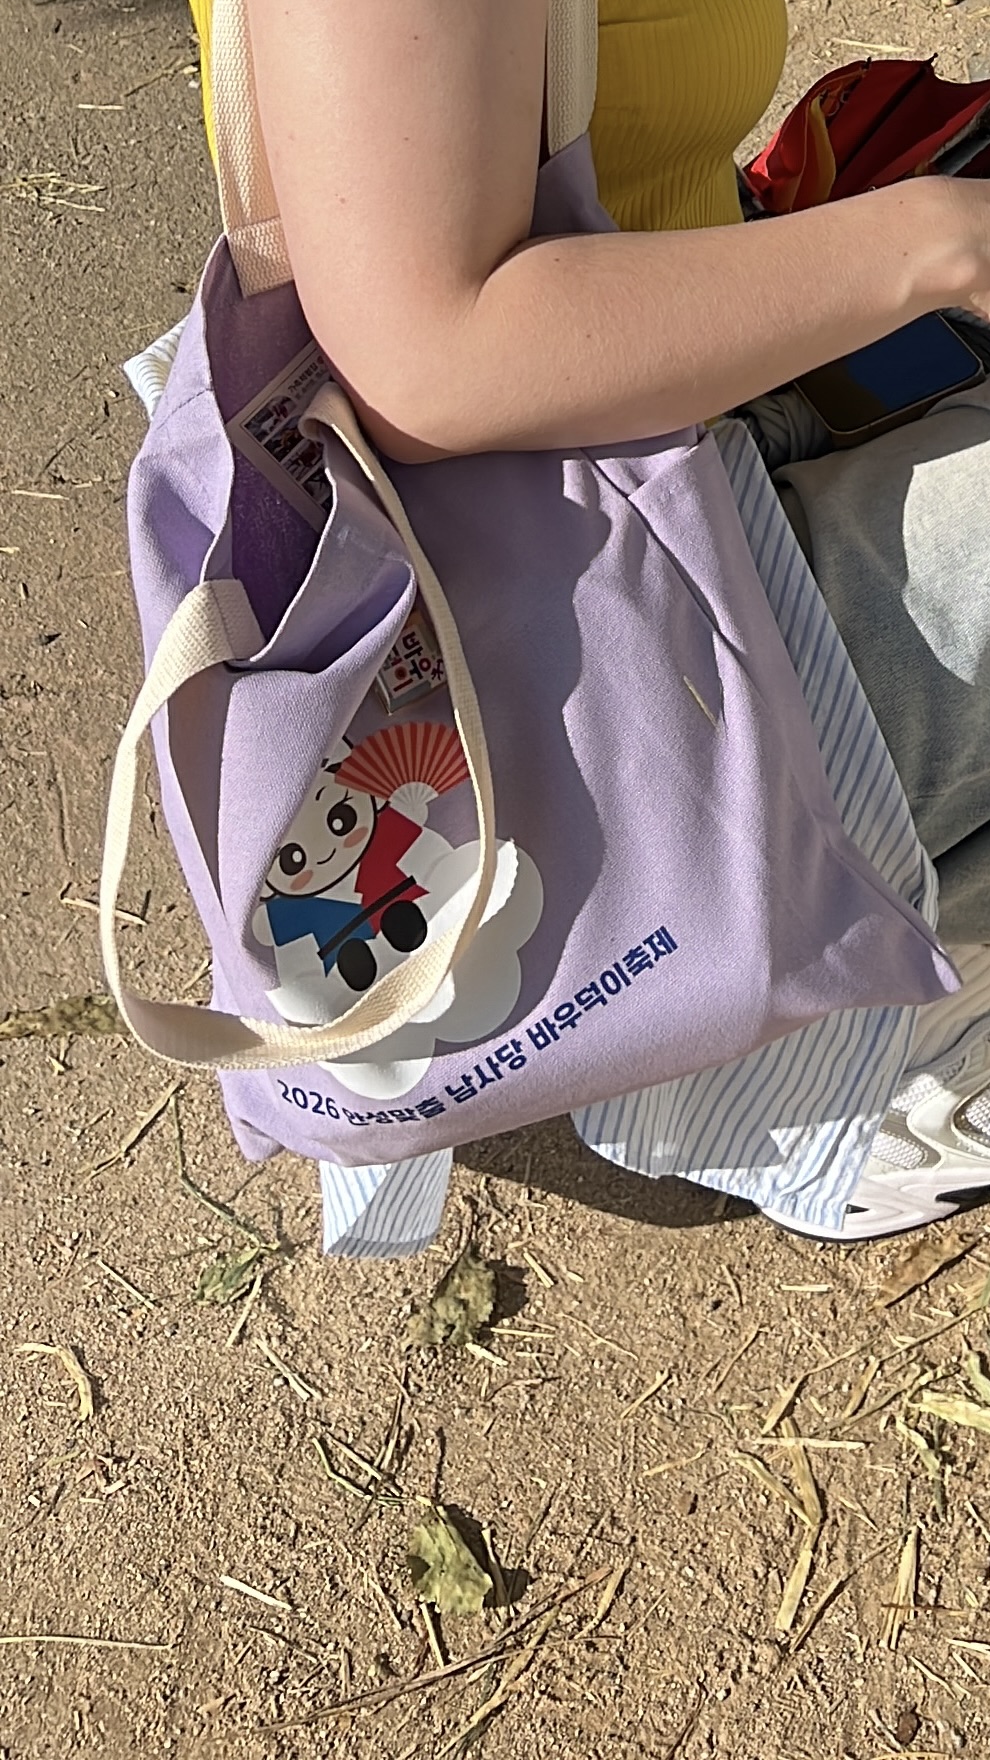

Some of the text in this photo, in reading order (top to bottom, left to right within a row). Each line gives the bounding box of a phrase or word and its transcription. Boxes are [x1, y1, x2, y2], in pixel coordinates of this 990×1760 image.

[277, 925, 679, 1126] 2026 안성맞춤 남사당 바우덕이축제
